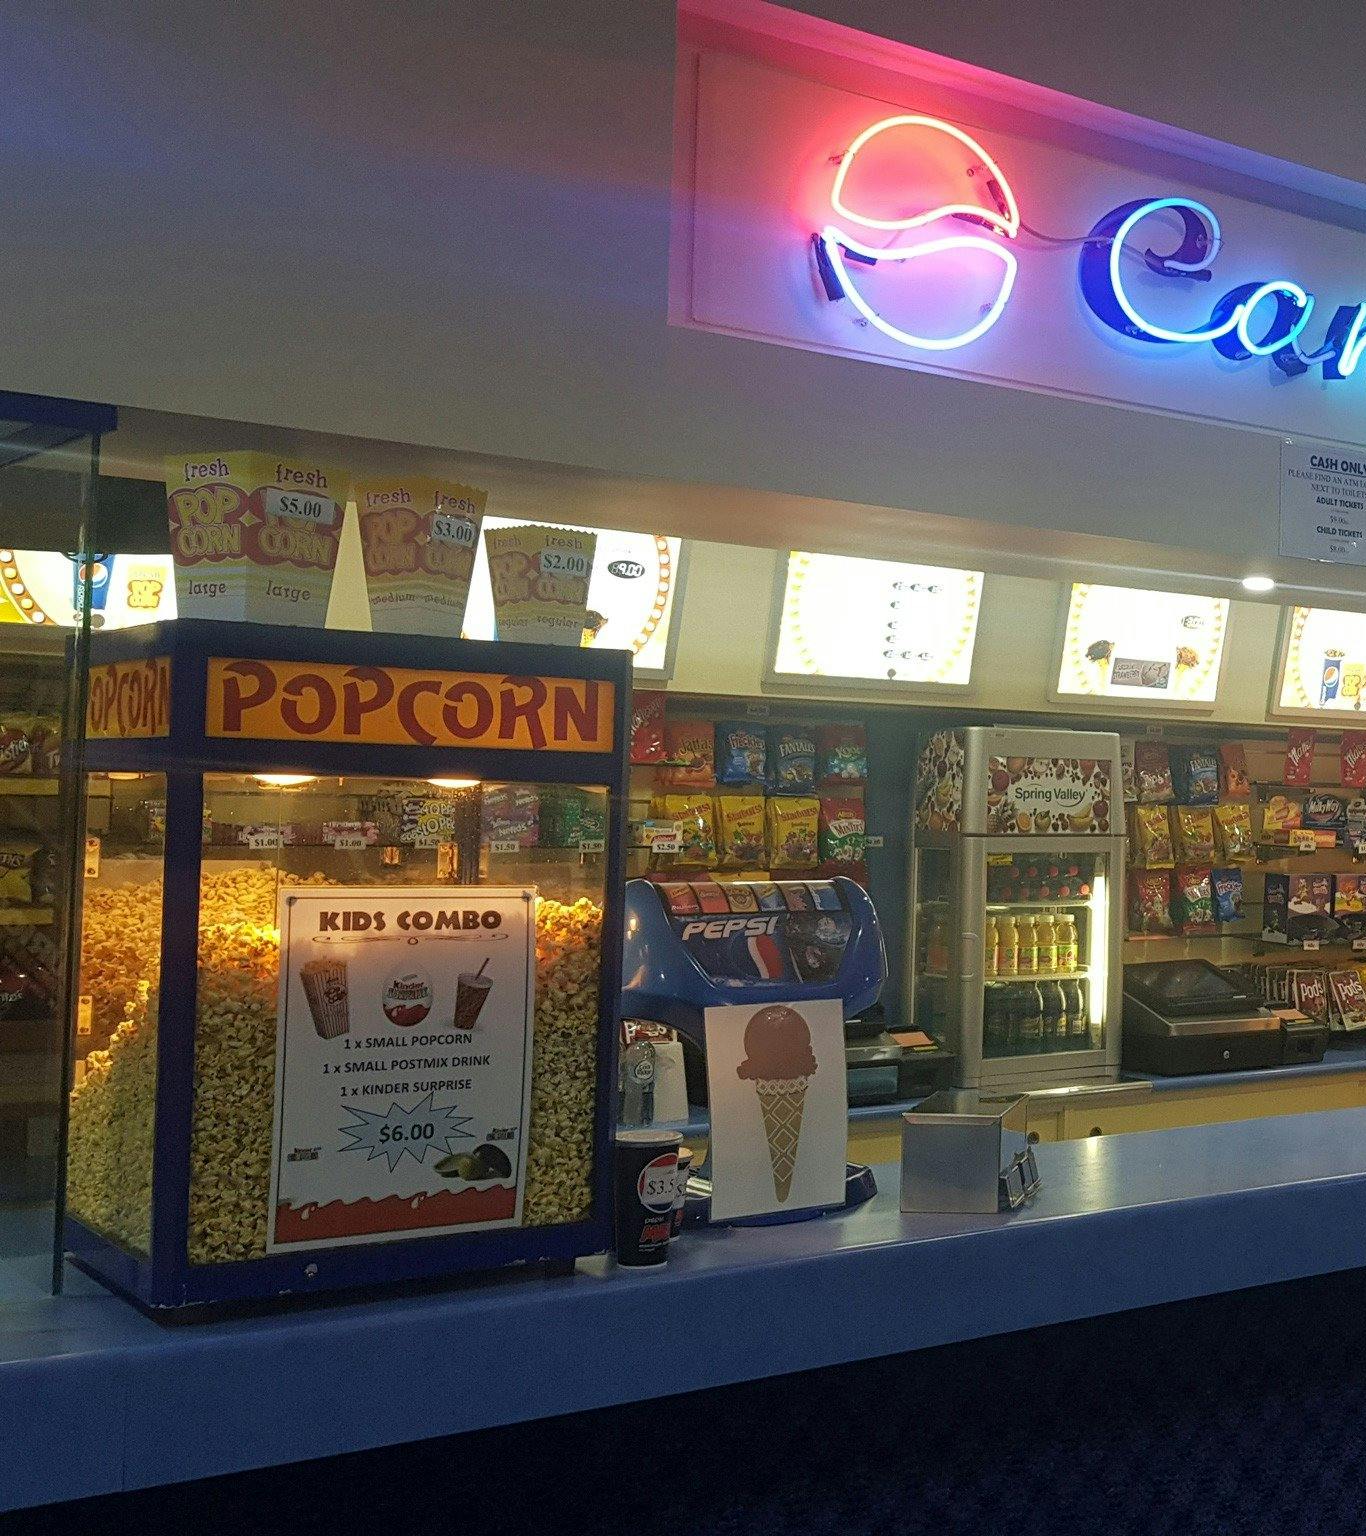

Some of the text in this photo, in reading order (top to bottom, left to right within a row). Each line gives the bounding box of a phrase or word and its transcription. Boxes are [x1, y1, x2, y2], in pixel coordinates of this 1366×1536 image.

[185, 458, 230, 482] fresh
[1310, 455, 1338, 470] CASH
[276, 463, 328, 489] fresh
[1288, 468, 1313, 480] PLEASE
[1315, 473, 1331, 483] FIND
[174, 487, 241, 528] POP
[279, 496, 322, 518] $5.00
[366, 488, 412, 507] fresh
[435, 491, 476, 514] fresh
[1316, 496, 1364, 510] ADULT TICKETS
[177, 524, 243, 558] CORN
[434, 520, 473, 542] $3.00
[1316, 526, 1363, 539] CHILD TICKETS
[543, 554, 585, 573] $2.00
[189, 580, 226, 597] large
[266, 580, 311, 602] large
[222, 659, 599, 750] POPCORN
[1014, 786, 1086, 803] Spring Valley
[656, 843, 676, 852] $2.50
[319, 910, 502, 932] KIDS COMBO
[682, 916, 779, 941] PEPSI
[1300, 979, 1324, 1001] Pods
[1338, 979, 1363, 1000] Pods
[344, 1033, 473, 1050] 1 x SMALL POPCORN
[323, 1054, 491, 1075] 1 x SMALL POSTMIX DRINK
[340, 1078, 473, 1097] 1 x KINDER SURPRISE
[379, 1122, 436, 1145] $6.00
